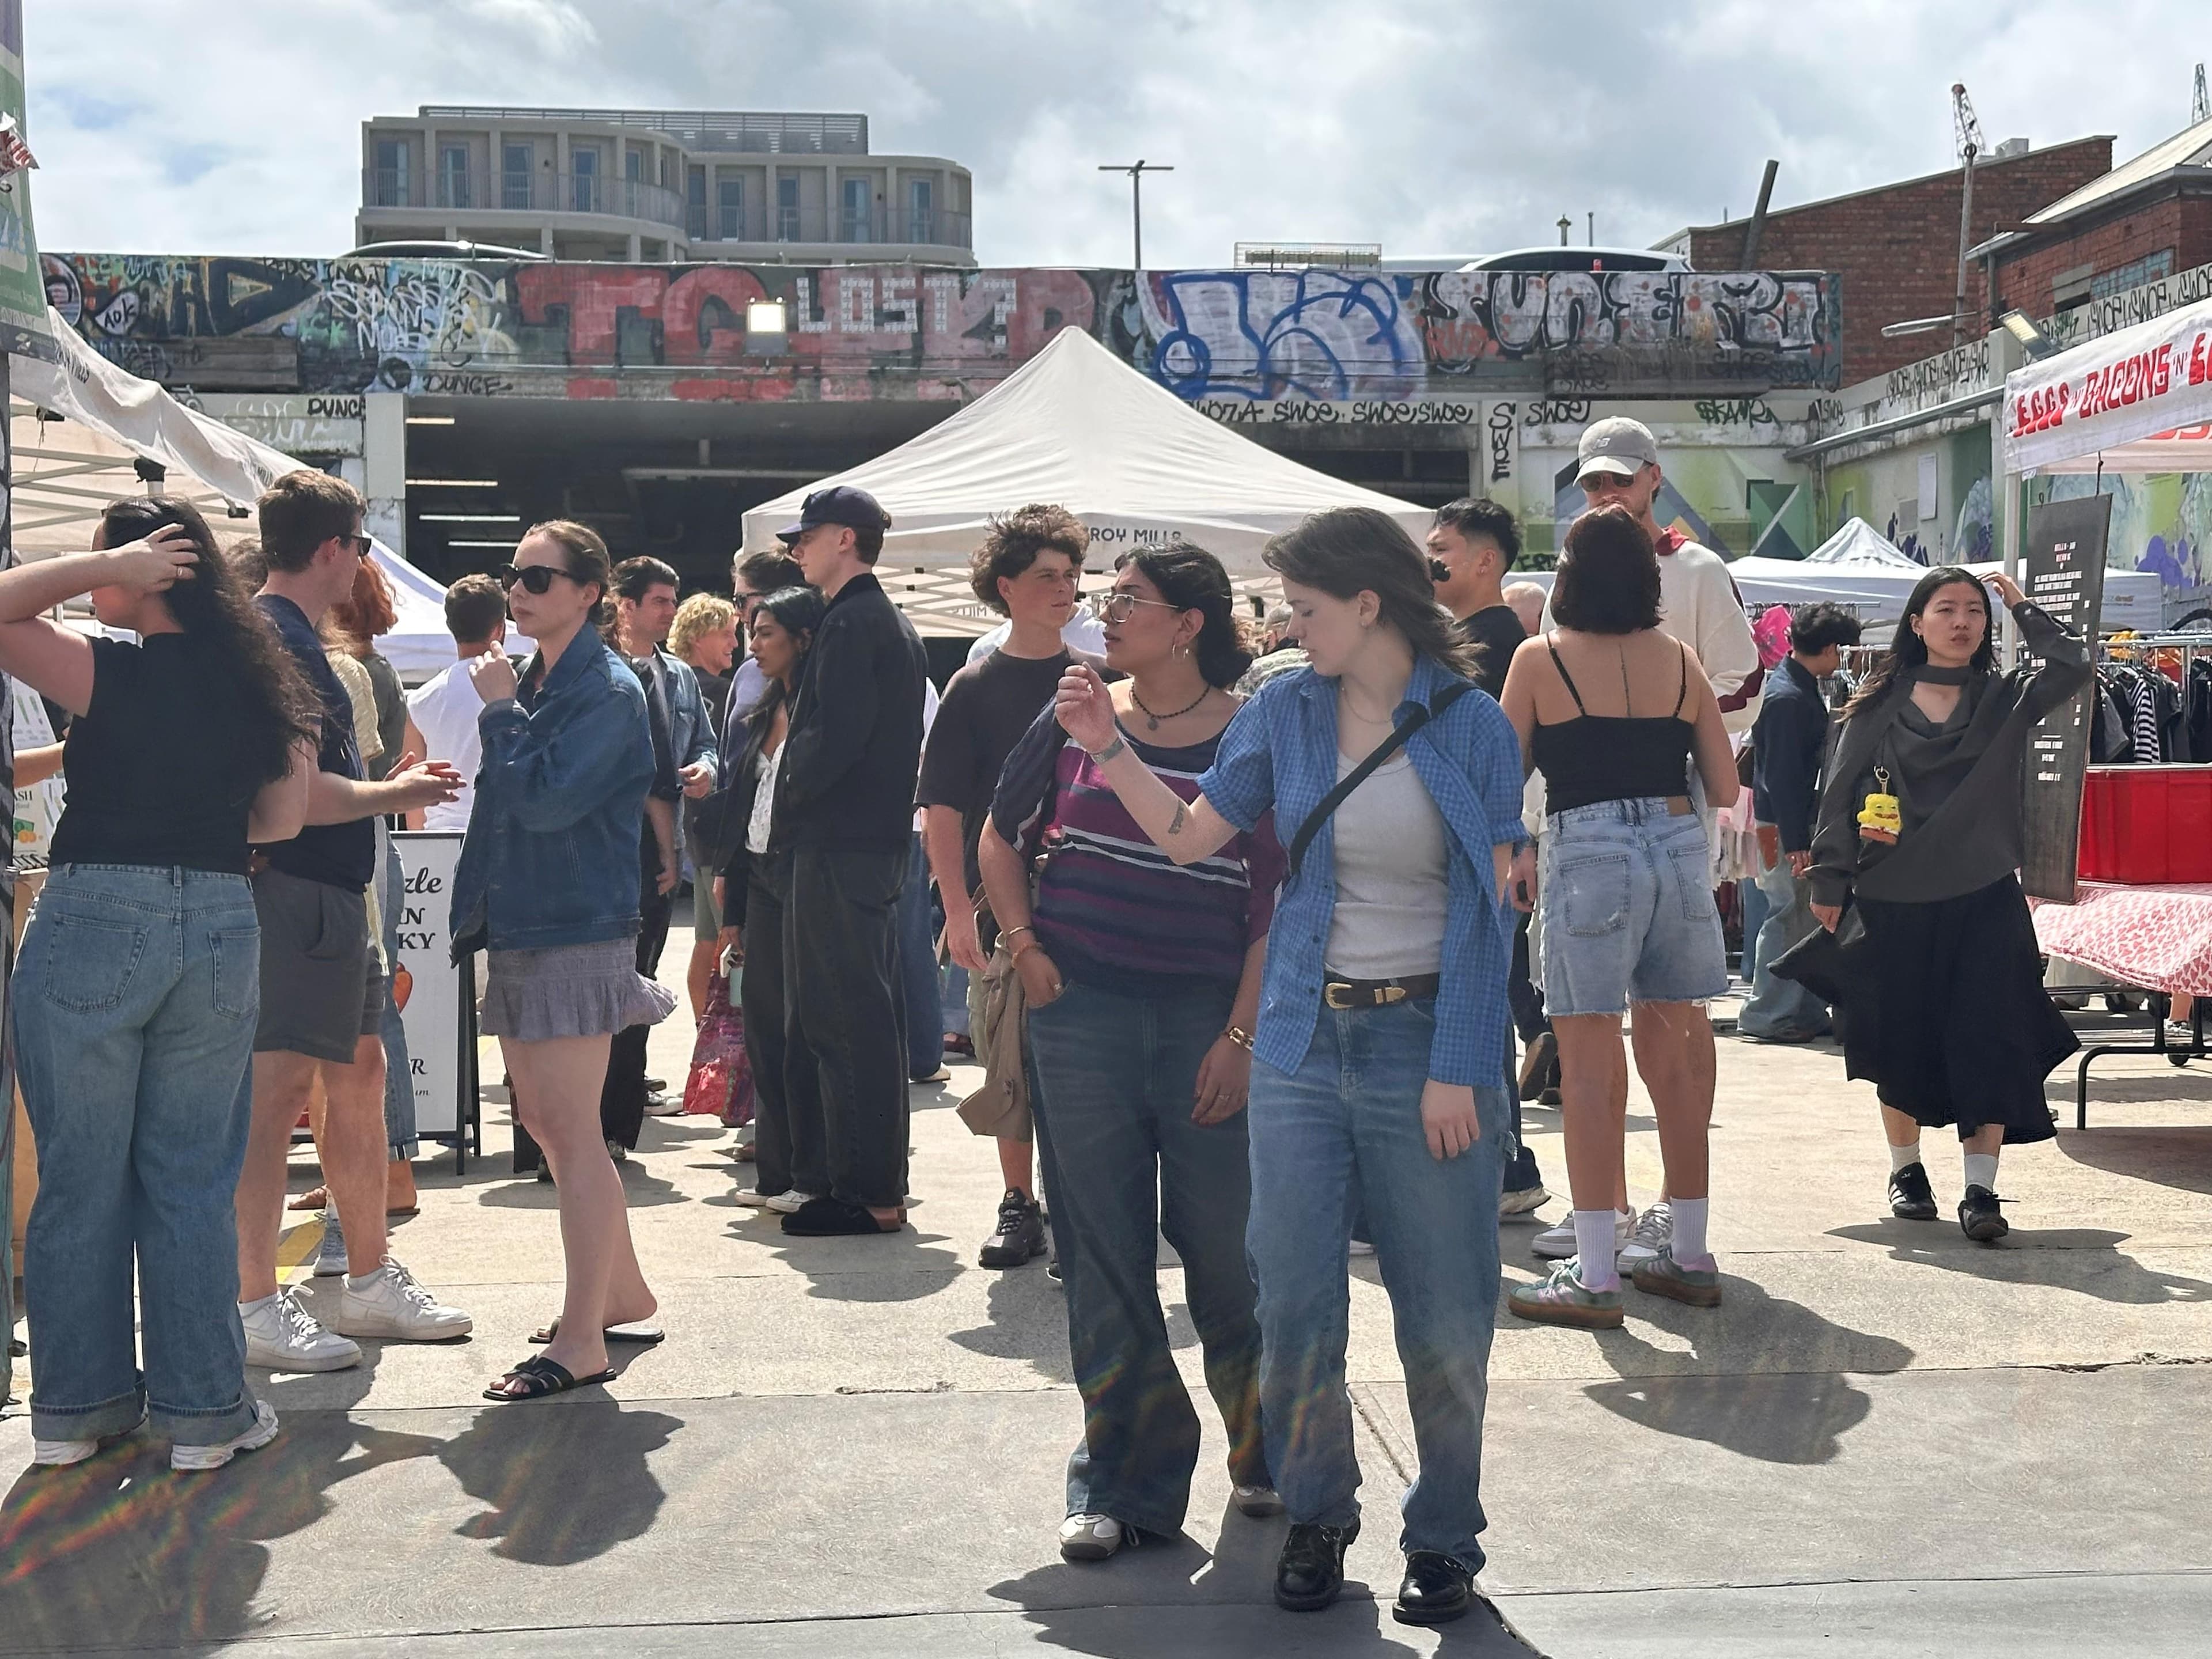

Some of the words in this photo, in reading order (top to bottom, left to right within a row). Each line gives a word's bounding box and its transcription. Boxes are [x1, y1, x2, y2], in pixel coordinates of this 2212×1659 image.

[1090, 527, 1127, 543] ROY
[404, 866, 443, 894] zle
[398, 932, 436, 949] KY
